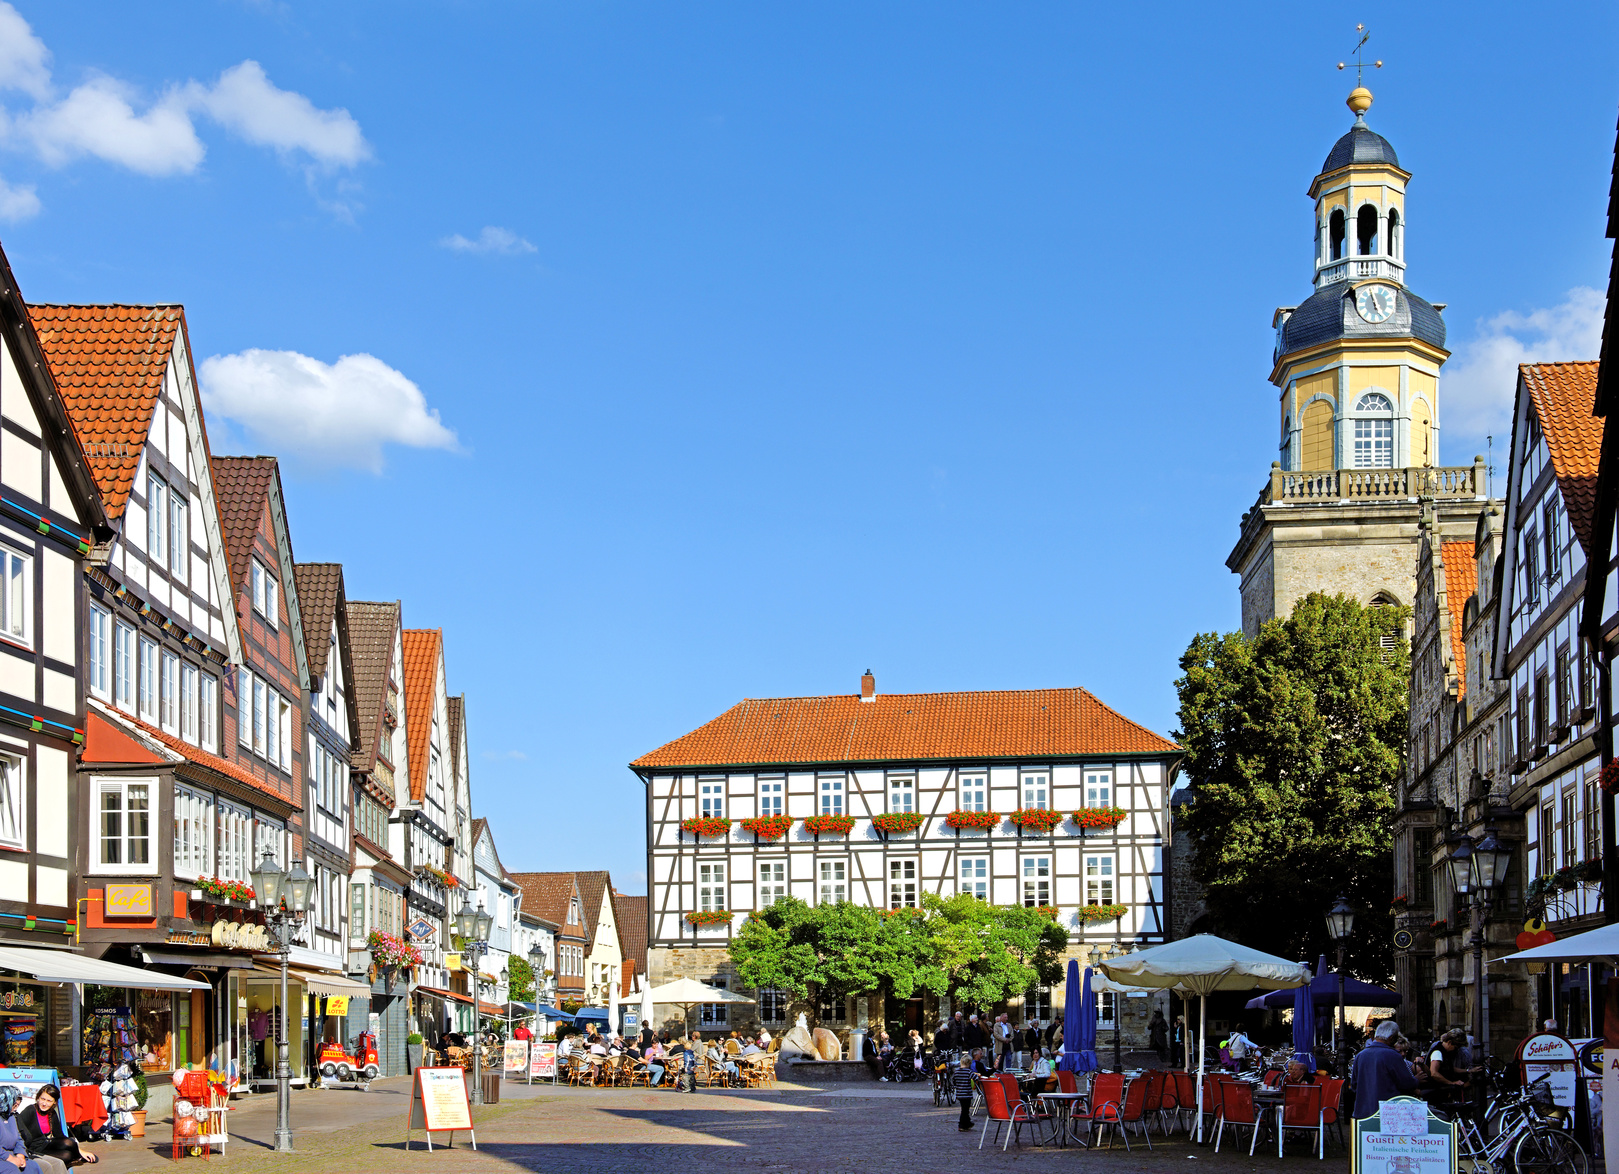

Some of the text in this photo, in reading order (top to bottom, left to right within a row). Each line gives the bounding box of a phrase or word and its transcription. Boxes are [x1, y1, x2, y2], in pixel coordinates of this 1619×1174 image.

[0, 990, 34, 1009] uginsel
[1528, 1041, 1563, 1057] Schäfer's
[1611, 1058, 1619, 1070] A
[1366, 1135, 1444, 1147] Gusti & Sapori
